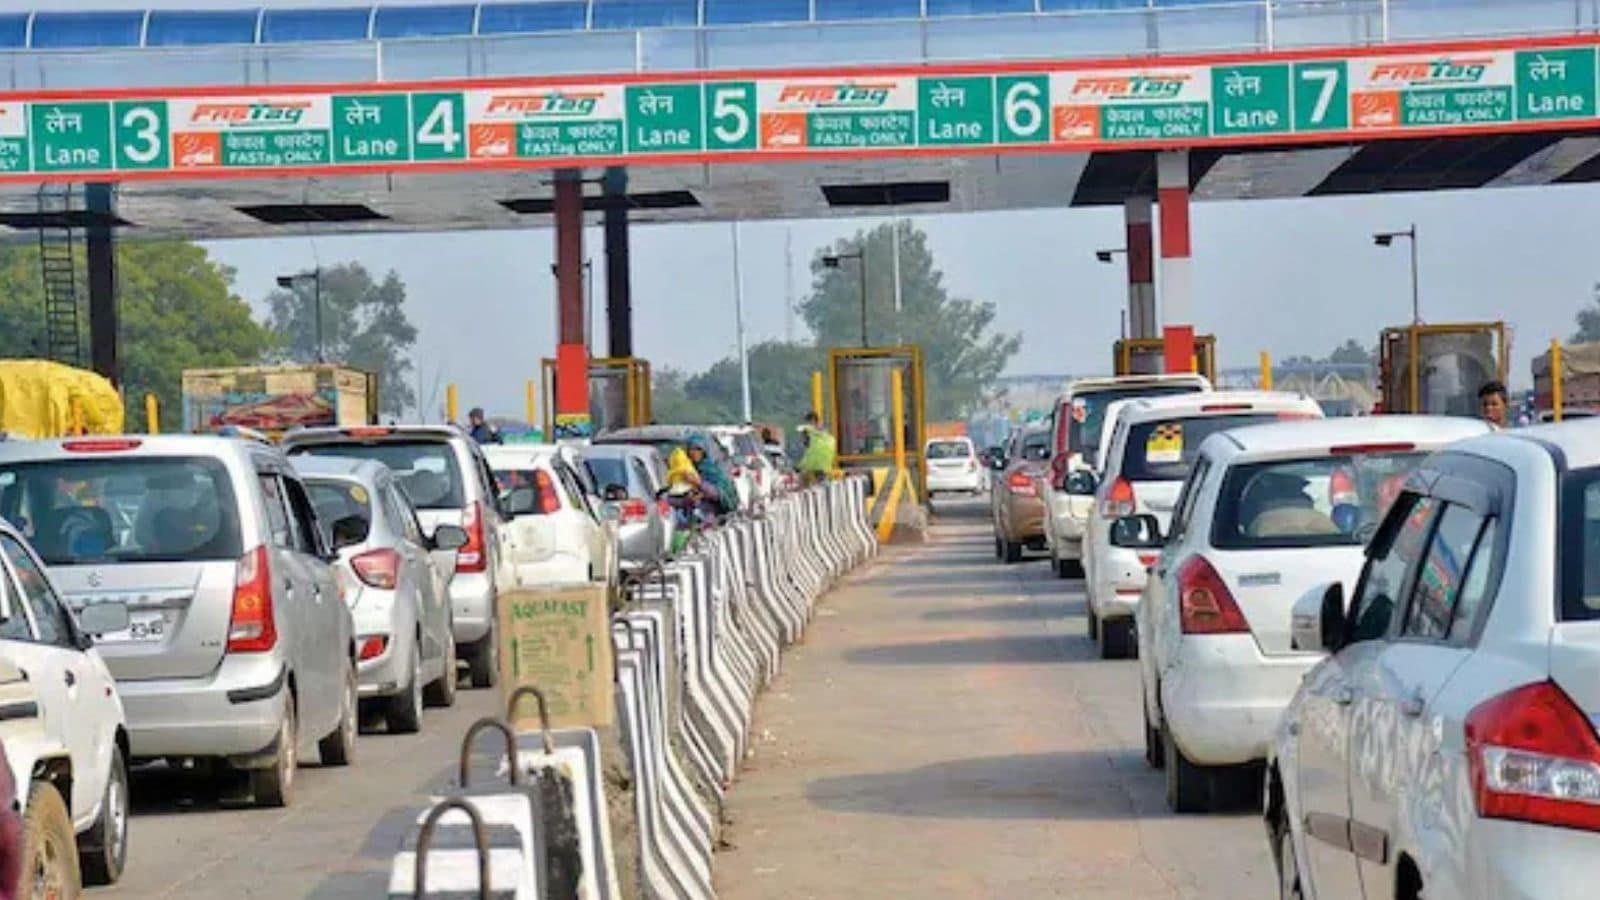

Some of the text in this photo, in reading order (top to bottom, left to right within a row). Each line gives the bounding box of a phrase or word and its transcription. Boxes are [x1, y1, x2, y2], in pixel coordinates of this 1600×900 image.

[1528, 54, 1566, 81] लेन
[929, 82, 965, 108] लेन
[1224, 71, 1262, 97] लेन
[638, 90, 674, 116] लेन
[1301, 69, 1339, 123] 7
[1528, 93, 1583, 113] Lane
[46, 106, 82, 133] लेन
[344, 100, 381, 125] लेन
[713, 88, 749, 144] 5
[1003, 81, 1042, 136] 6
[1224, 108, 1279, 128] Lane
[1464, 107, 1504, 120] ONLY
[122, 107, 161, 163] 3
[416, 100, 460, 152] 4
[638, 127, 691, 147] Lane
[870, 131, 907, 143] ONLY
[929, 119, 983, 138] Lane
[1163, 123, 1201, 135] ONLY
[46, 144, 99, 164] Lane
[285, 149, 322, 161] ONLY
[344, 136, 397, 155] Lane
[578, 140, 615, 152] ONLY
